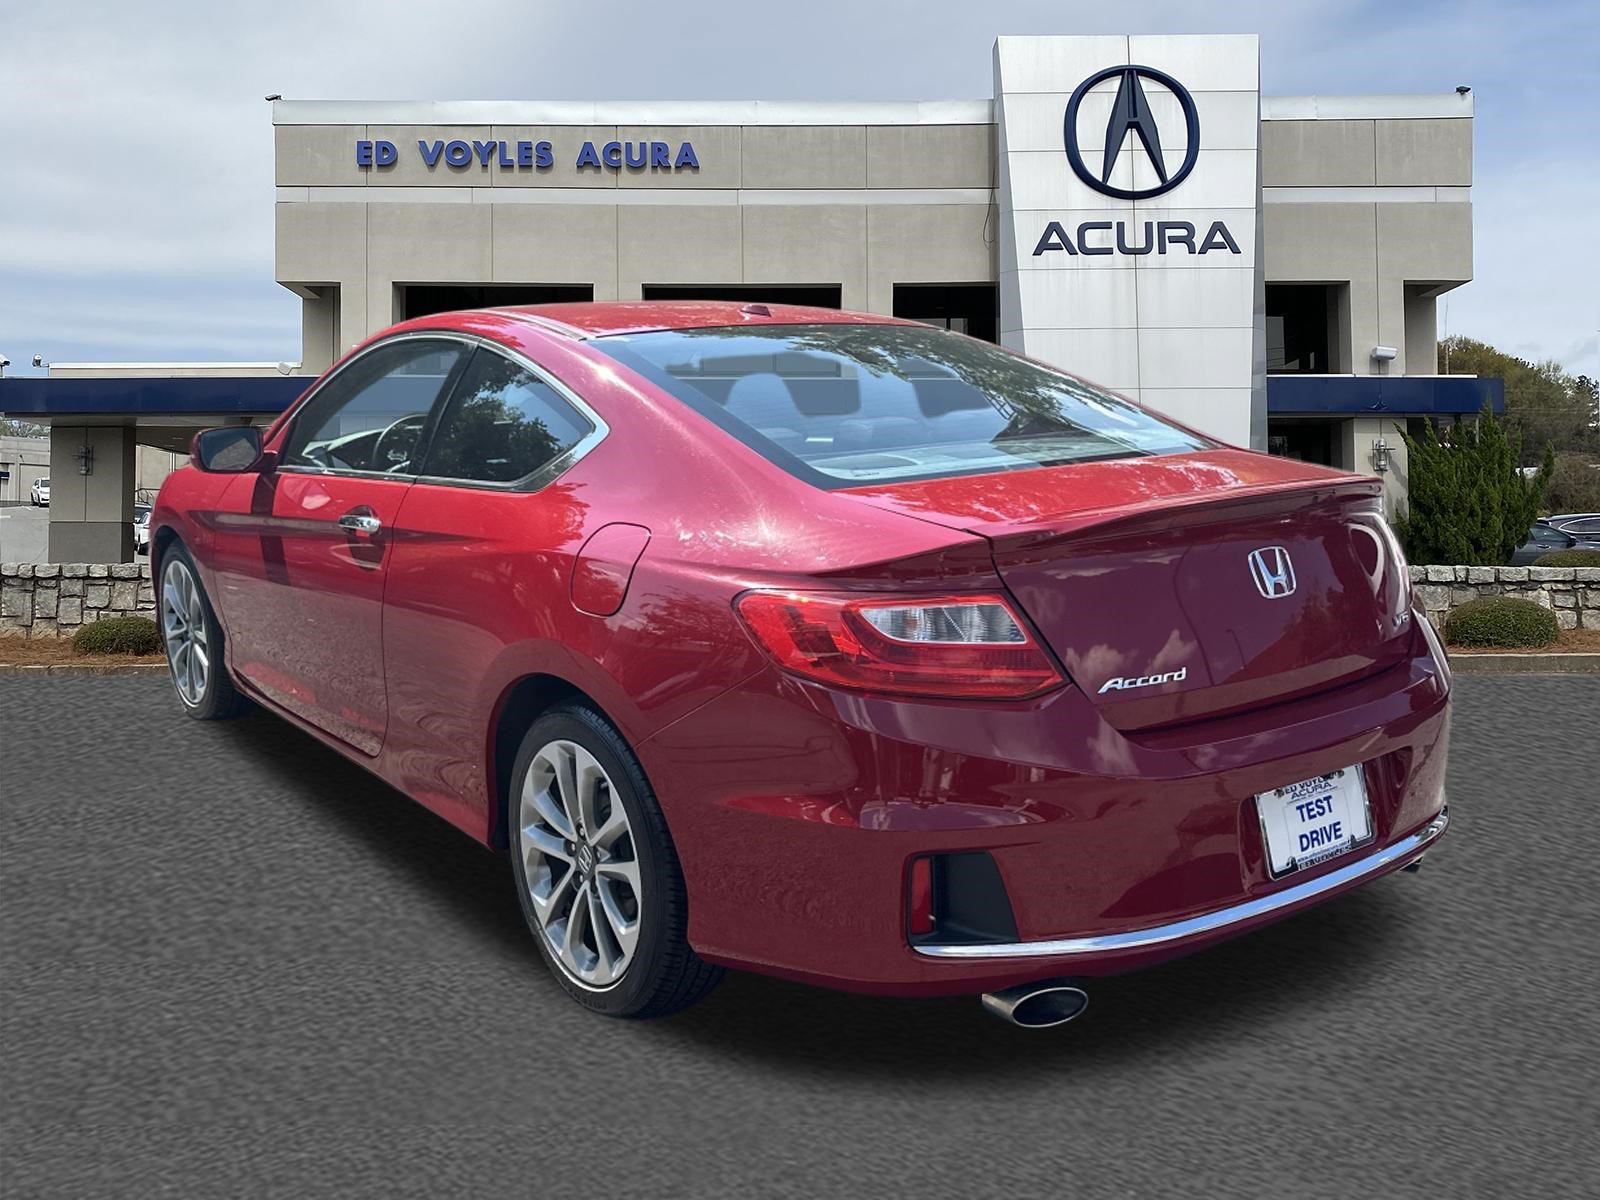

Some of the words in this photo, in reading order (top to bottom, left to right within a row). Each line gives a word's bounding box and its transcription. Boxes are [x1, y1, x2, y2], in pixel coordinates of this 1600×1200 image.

[356, 140, 398, 168] ED
[418, 140, 554, 169] VOYLES
[576, 141, 700, 169] ACURA
[1032, 221, 1242, 256] ACURA
[1097, 667, 1187, 694] Accord
[1291, 782, 1332, 800] ACURA
[1296, 795, 1333, 823] TEST
[1298, 821, 1343, 852] DRIVE
